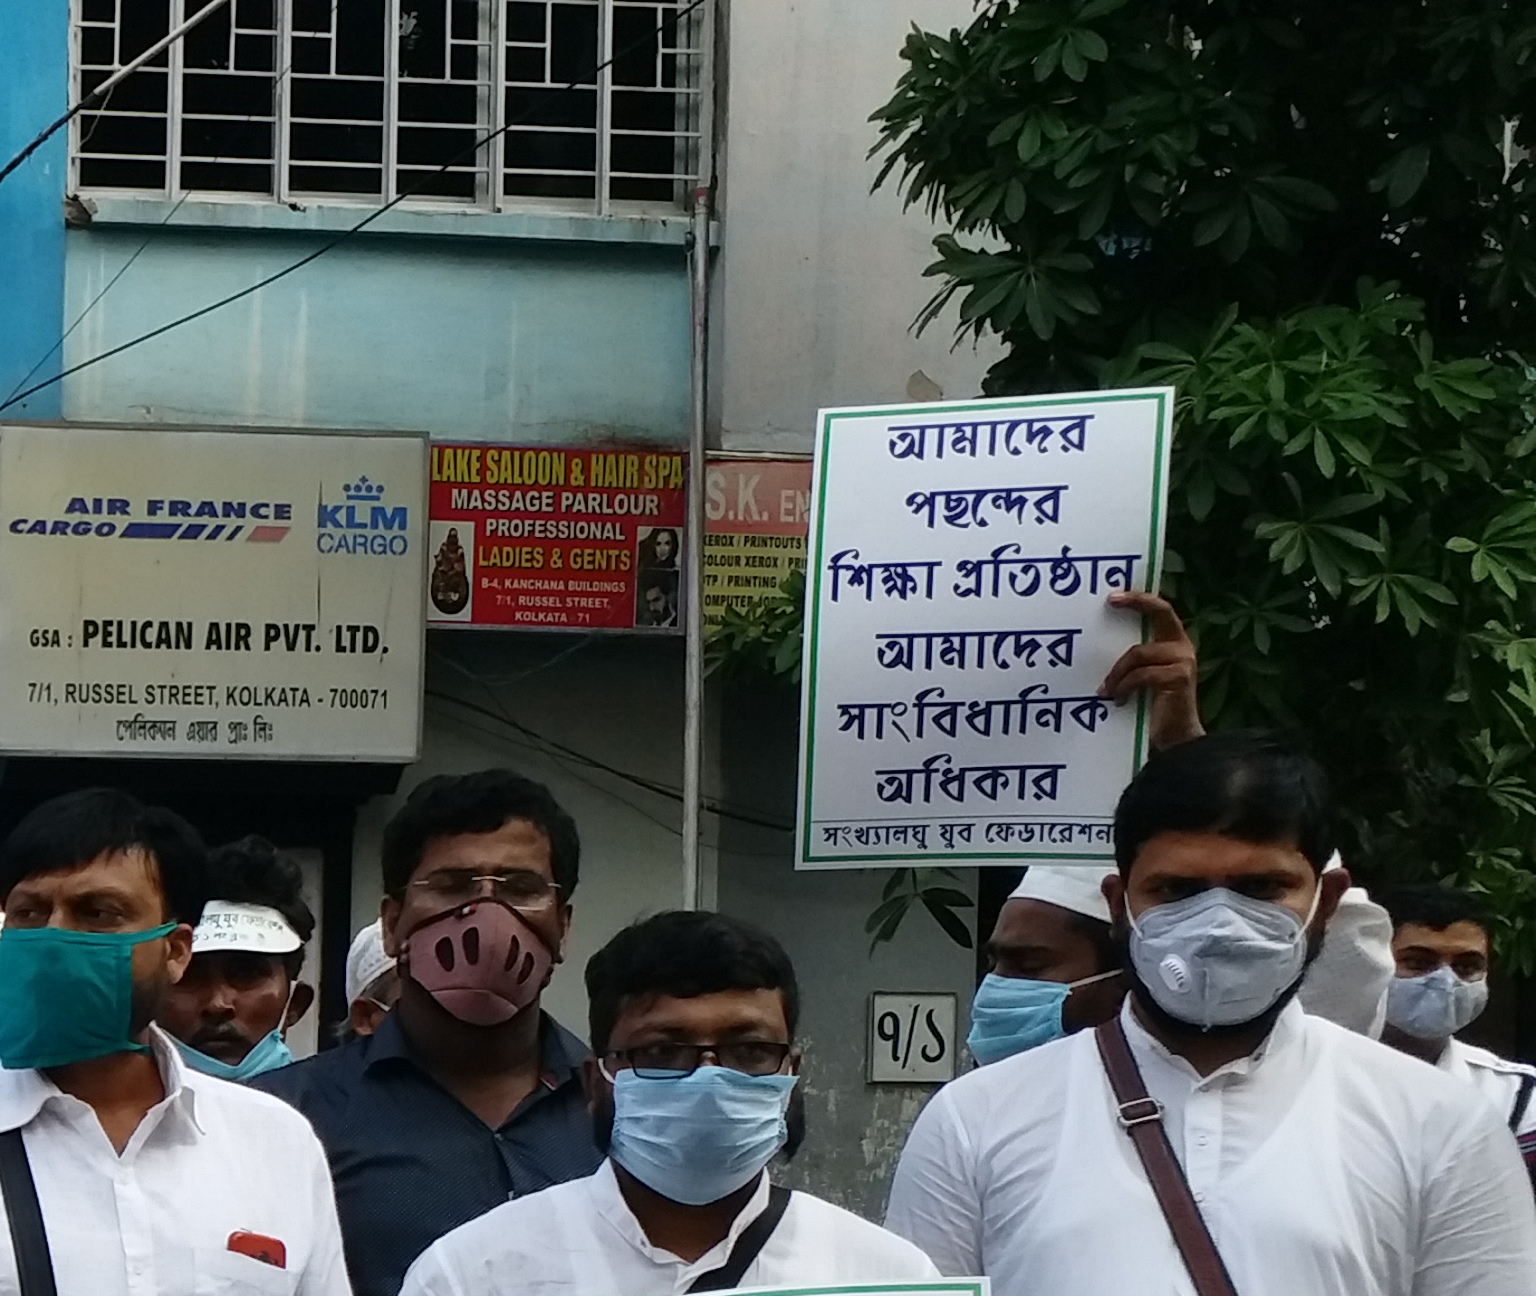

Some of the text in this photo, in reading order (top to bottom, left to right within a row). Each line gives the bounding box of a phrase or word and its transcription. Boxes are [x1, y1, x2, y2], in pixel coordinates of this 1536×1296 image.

[887, 414, 1095, 460] আমাদের
[432, 448, 683, 489] LAKE SALOON & HAIR SPA
[65, 498, 292, 520] AIR FRANCE
[451, 488, 659, 516] MASSAGE PARLOUR
[705, 470, 770, 522] S.K.
[905, 485, 1069, 529] পছন্দের
[9, 519, 117, 537] CARGO
[318, 504, 408, 531] KLM
[485, 518, 626, 541] PROFESSIONAL
[317, 532, 408, 555] CARGO
[743, 535, 801, 550] PRINTOUTS
[479, 546, 631, 571] LADIES & GENTS
[744, 555, 779, 569] XEROX
[504, 577, 565, 591] KANCHANA
[568, 580, 626, 592] BUILDINGS
[726, 575, 778, 588] PRINTING
[828, 544, 1142, 603] শিক্ষা প্রতিষ্ঠান
[518, 596, 562, 608] RUSSEL
[515, 611, 568, 623] KOLKATA
[30, 628, 61, 648] GSA
[82, 619, 193, 651] PELICAN
[205, 622, 252, 651] AIR
[263, 623, 322, 653] PVT.
[335, 625, 389, 655] LTD.
[875, 629, 1082, 671] আমাদের
[27, 683, 58, 706] 7/1,
[65, 684, 138, 705] RUSSEL
[144, 684, 220, 708] STREET,
[226, 686, 312, 708] KOLKATA
[329, 688, 388, 709] 700071
[837, 684, 1114, 742] সাংবিধানিক
[875, 754, 1066, 804] অধিকার
[823, 822, 930, 850] সংখ্যালঘু
[939, 823, 973, 850] যুব
